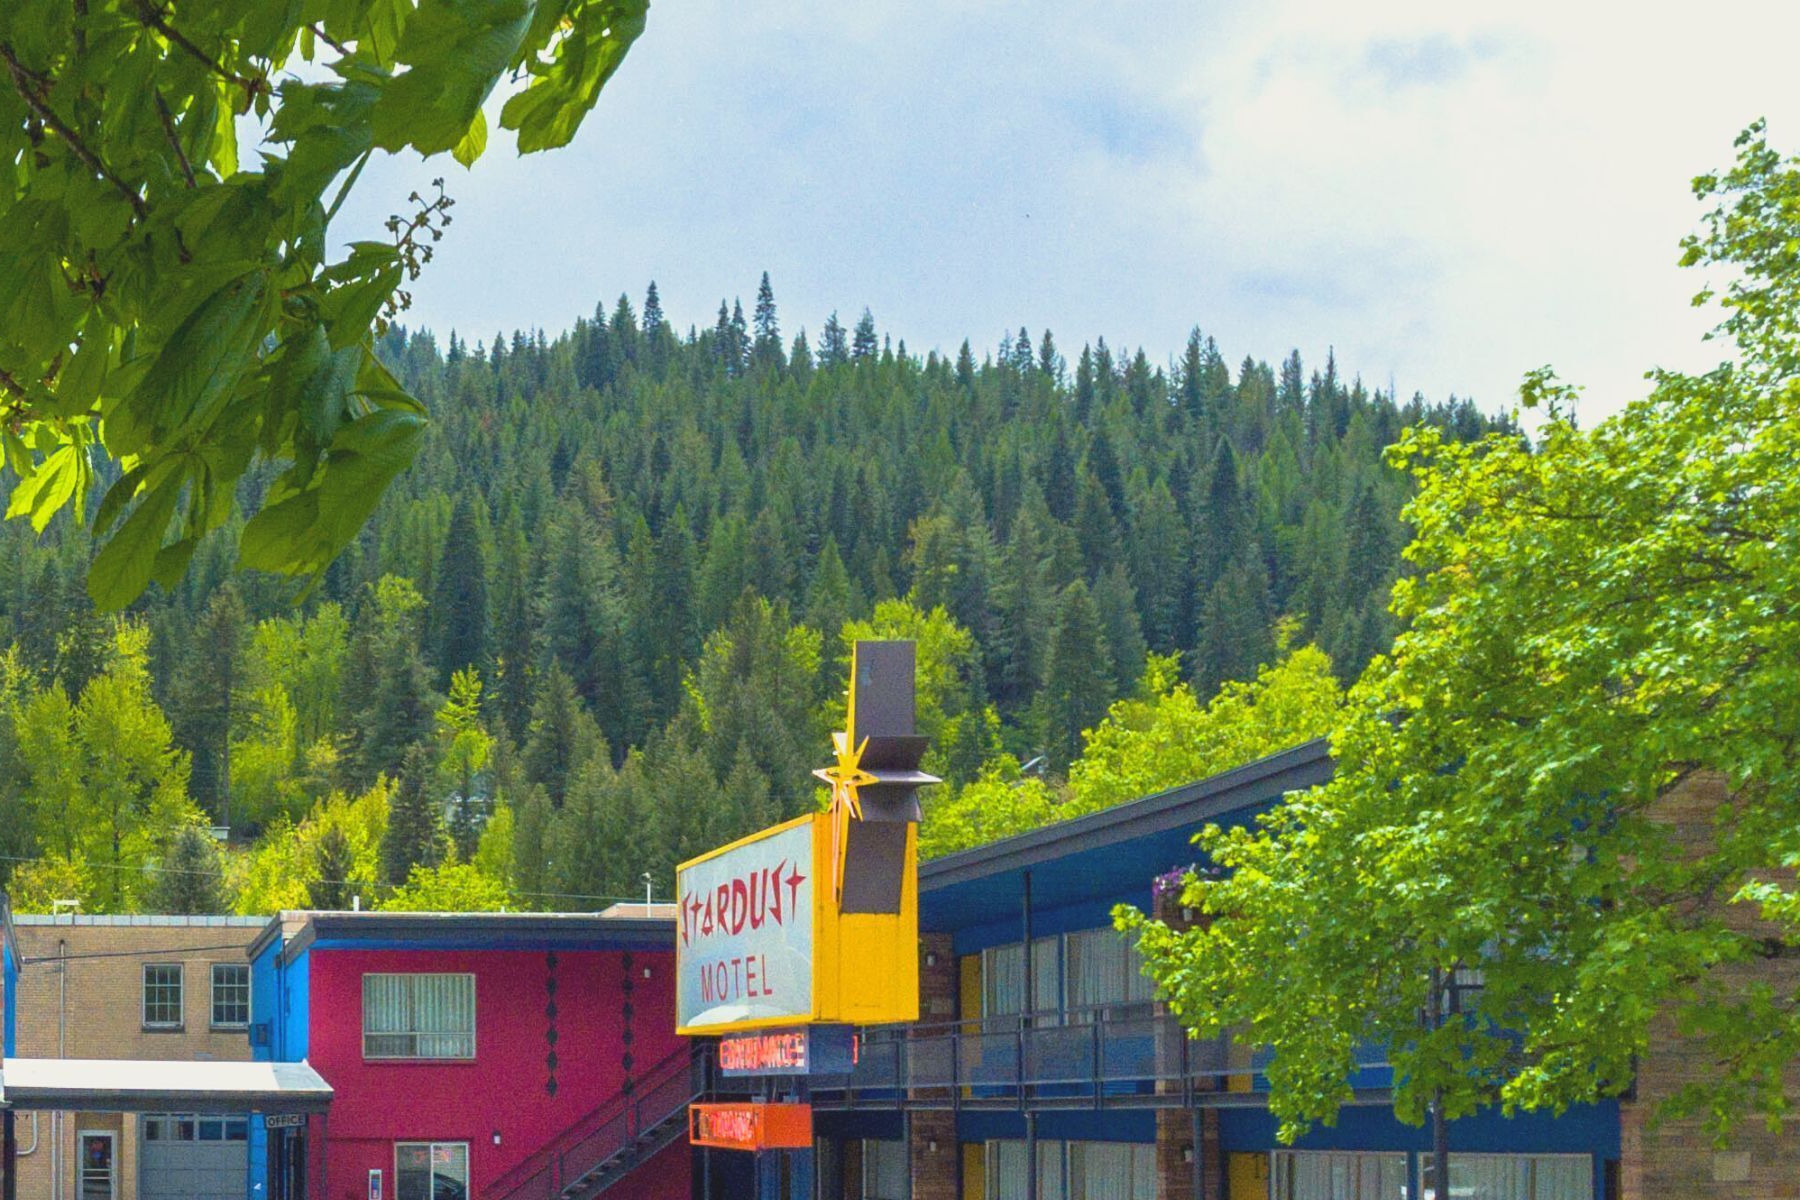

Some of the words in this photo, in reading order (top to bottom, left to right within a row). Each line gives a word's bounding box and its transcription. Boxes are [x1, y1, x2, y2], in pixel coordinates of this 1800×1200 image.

[682, 858, 806, 948] STARDUST
[701, 954, 773, 1003] MOTEL
[268, 1115, 304, 1126] OFFICE
